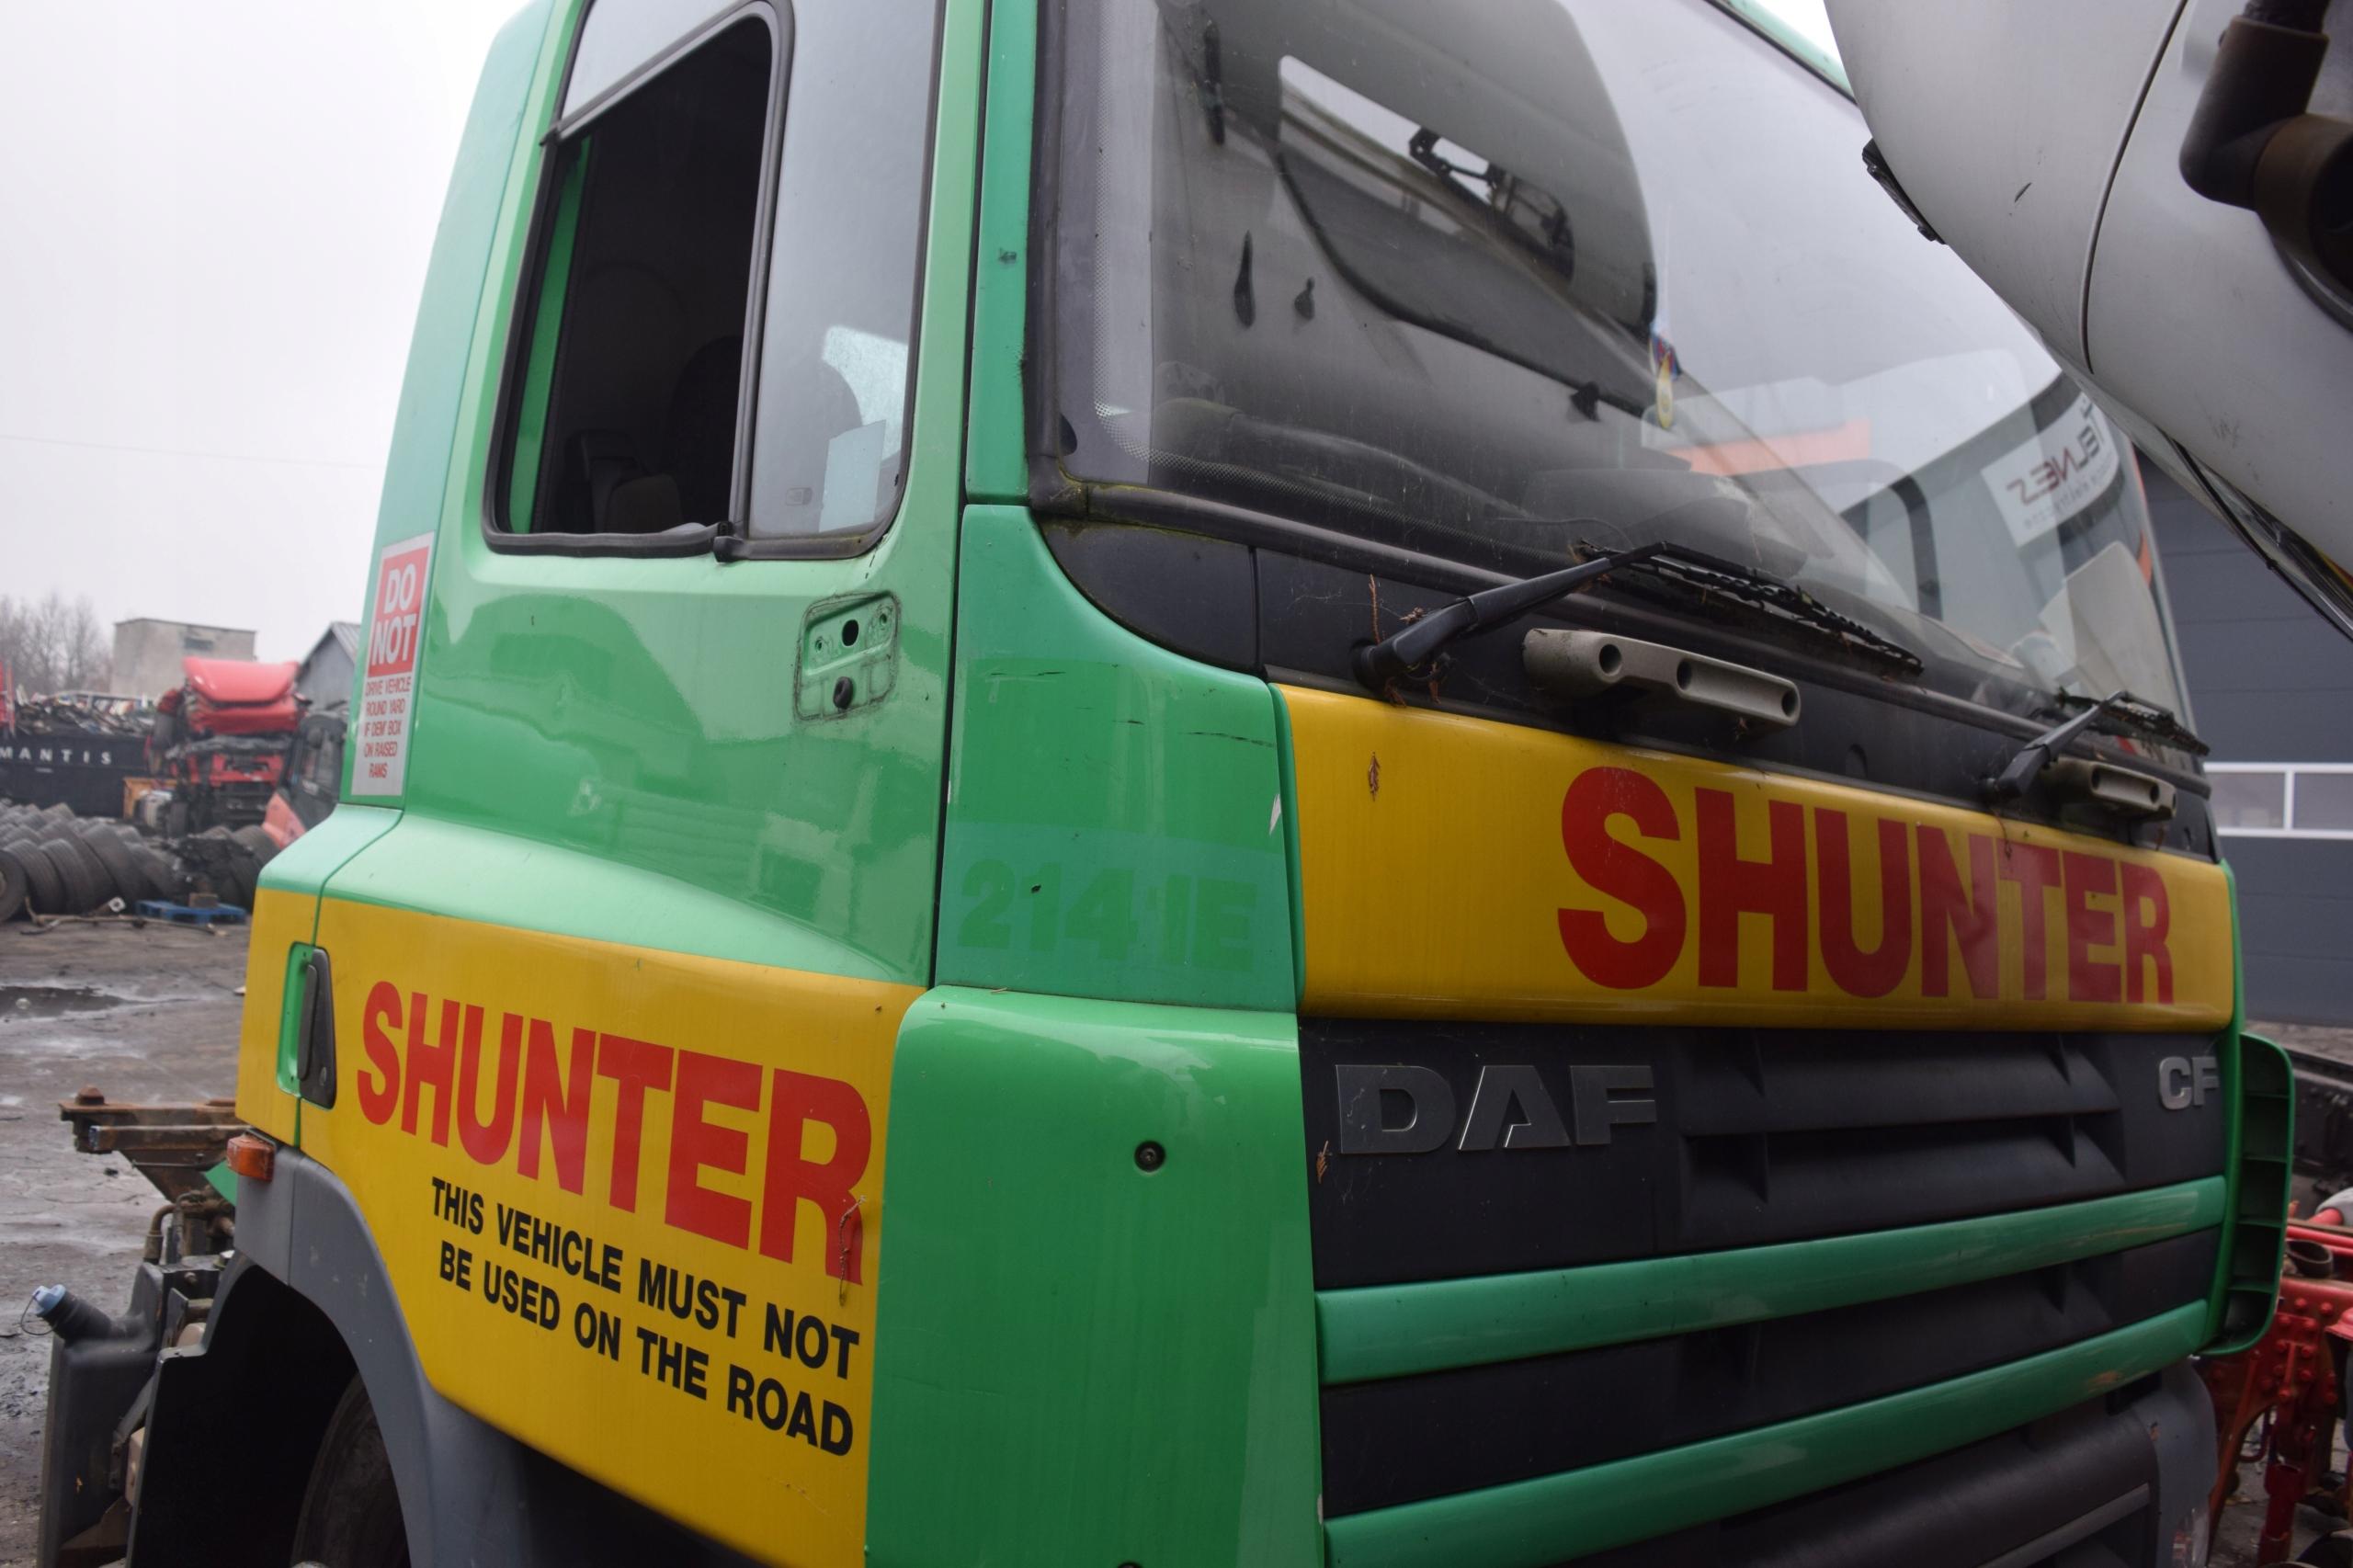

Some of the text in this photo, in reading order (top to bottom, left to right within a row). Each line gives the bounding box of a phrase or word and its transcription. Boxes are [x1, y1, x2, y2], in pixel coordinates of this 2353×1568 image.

[383, 562, 416, 614] DO
[371, 613, 417, 666] NOT
[367, 699, 404, 717] ROUND YARD
[385, 676, 412, 694] VEHICLE
[369, 763, 387, 778] RAMS
[374, 741, 398, 757] RAISED
[1558, 766, 2174, 1005] SHUNTER
[1336, 1064, 1657, 1154] DAF
[2158, 1055, 2220, 1110] CF
[357, 981, 872, 1286] SHUNTER
[431, 1176, 860, 1380] THIS VEHICLE MUST NOT
[439, 1240, 854, 1457] BE USED ON THE ROAD
